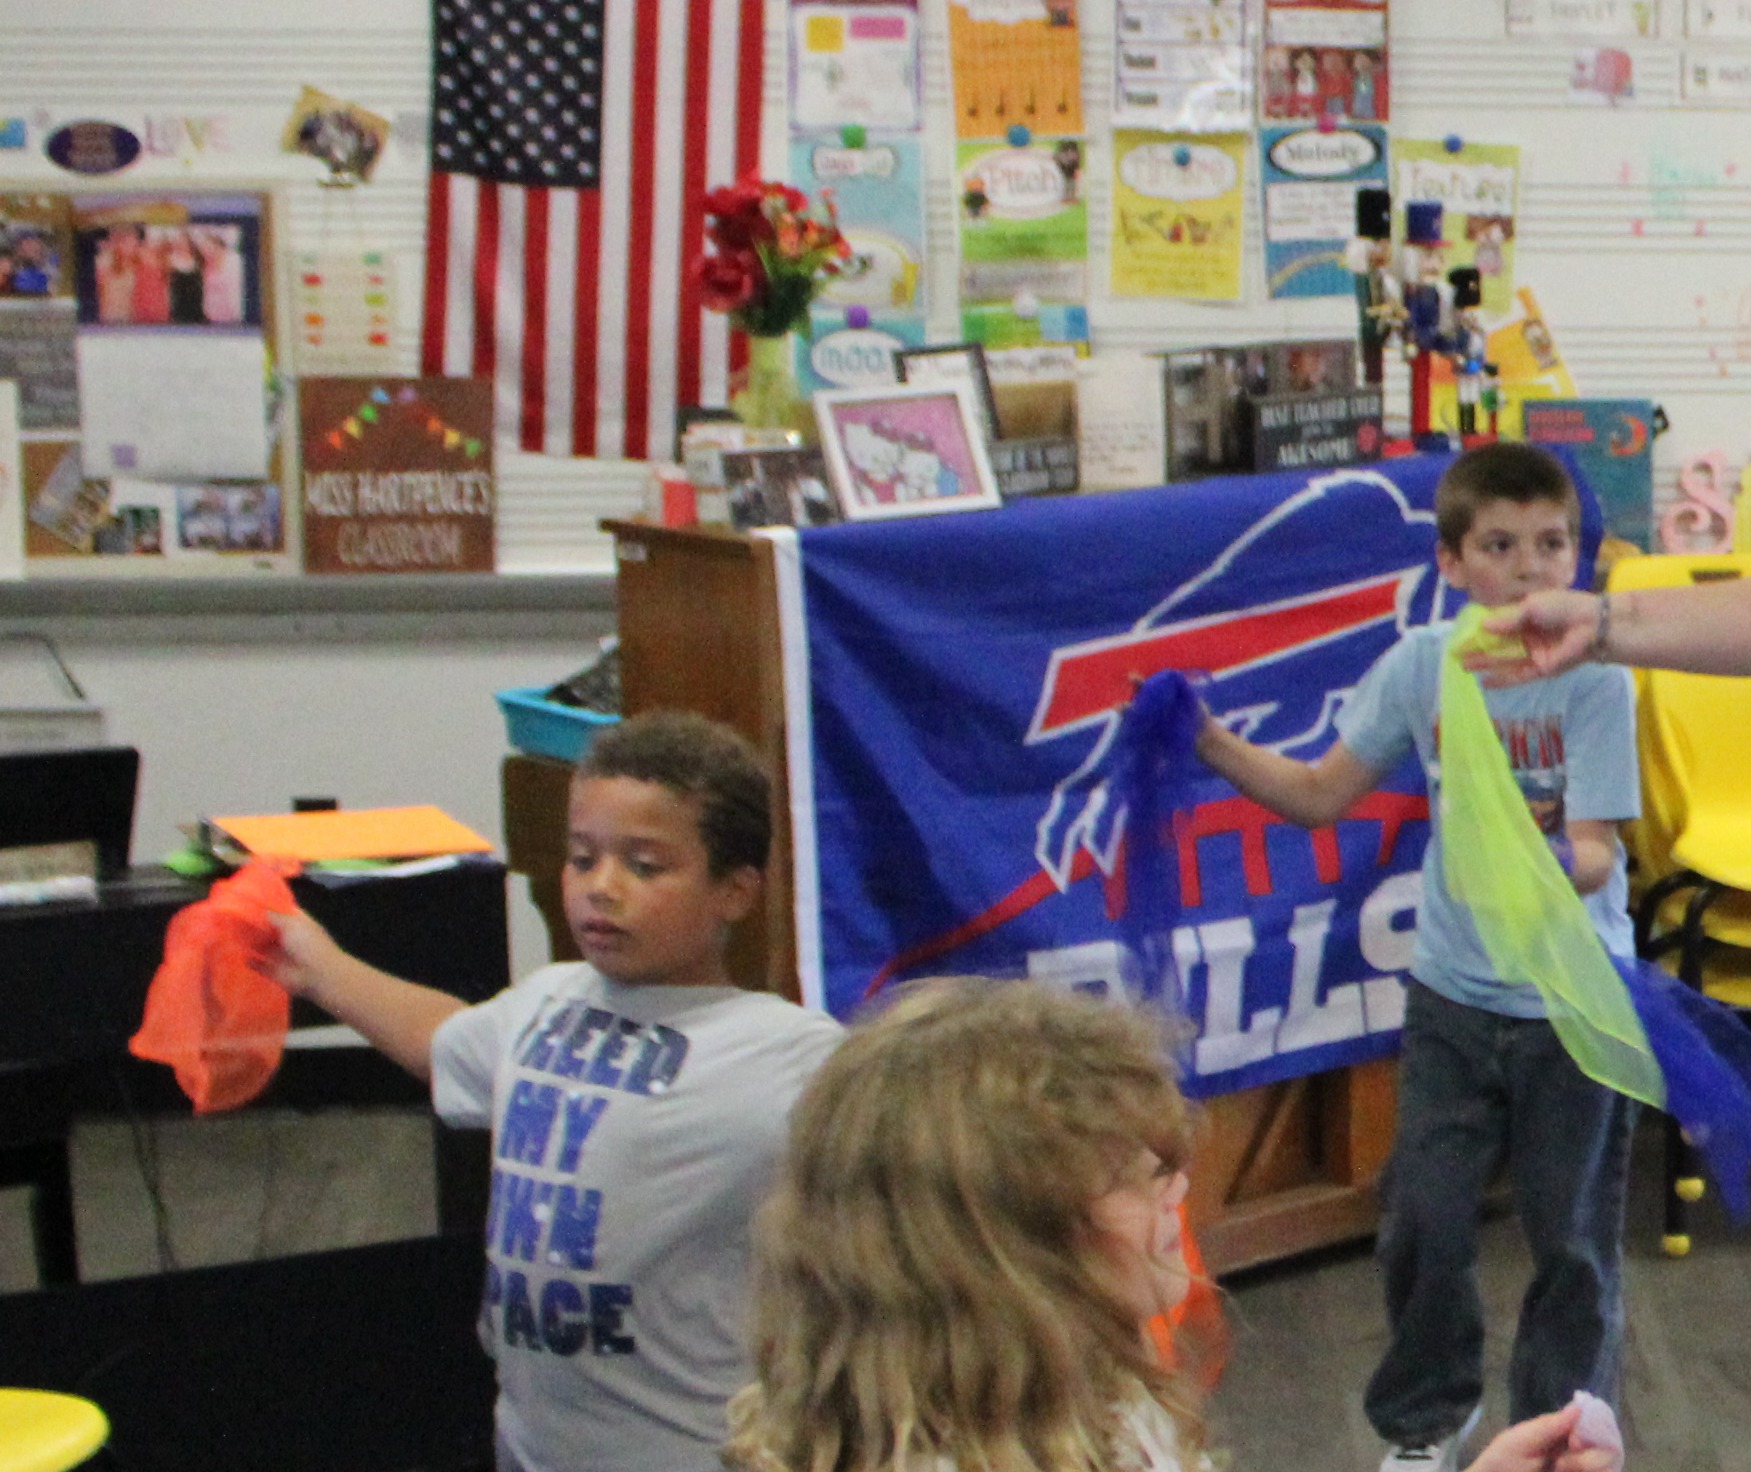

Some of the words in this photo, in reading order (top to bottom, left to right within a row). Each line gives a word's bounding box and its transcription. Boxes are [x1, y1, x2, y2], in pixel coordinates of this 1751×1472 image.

[1285, 137, 1360, 166] Melody
[337, 521, 463, 566] CLASSROOM
[500, 1077, 612, 1174] MY
